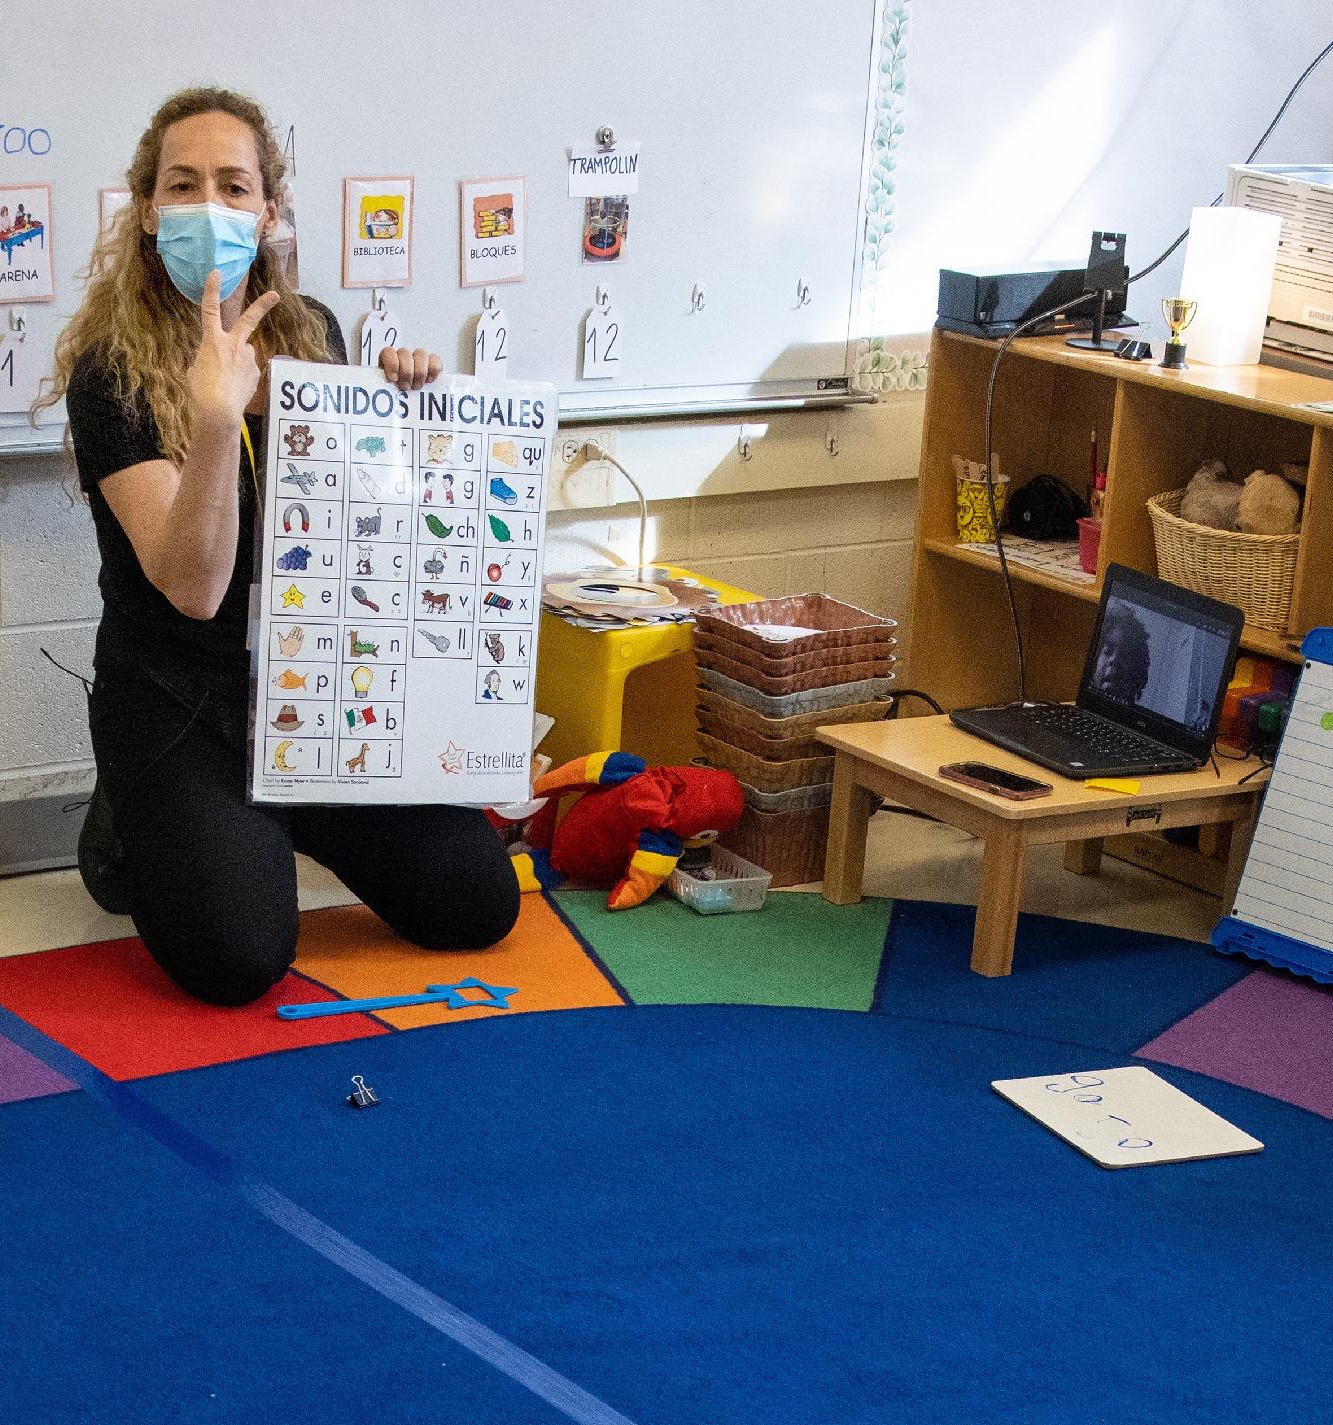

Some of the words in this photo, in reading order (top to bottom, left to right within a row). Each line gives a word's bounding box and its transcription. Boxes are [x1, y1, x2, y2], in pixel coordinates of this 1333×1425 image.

[569, 153, 638, 175] TRAMPOLIN
[353, 246, 405, 256] BIBLIOTECA
[470, 245, 517, 259] BLOQUES
[0, 269, 38, 284] ARENA
[279, 380, 409, 420] SONIDOS
[419, 391, 545, 429] INICIALES
[326, 437, 337, 450] o
[463, 443, 474, 462] g
[522, 447, 542, 466] qu
[325, 473, 337, 487] a
[463, 480, 474, 499] g
[526, 486, 536, 499] z
[327, 509, 332, 529] i
[396, 519, 403, 533] r
[457, 515, 475, 538] ch
[524, 519, 532, 541] h
[322, 554, 333, 567] u
[393, 555, 402, 568] c
[460, 555, 469, 573] ñ
[521, 561, 531, 580] y
[321, 590, 332, 604] e
[391, 592, 401, 606] c
[459, 596, 469, 608] v
[519, 598, 528, 610] x
[317, 637, 333, 650] m
[390, 639, 400, 652] n
[458, 628, 466, 650] ll
[518, 634, 526, 657] k
[316, 674, 329, 694] p
[390, 669, 397, 692] f
[512, 679, 526, 691] w
[317, 713, 325, 726] s
[386, 707, 397, 730] b
[385, 743, 392, 769] j
